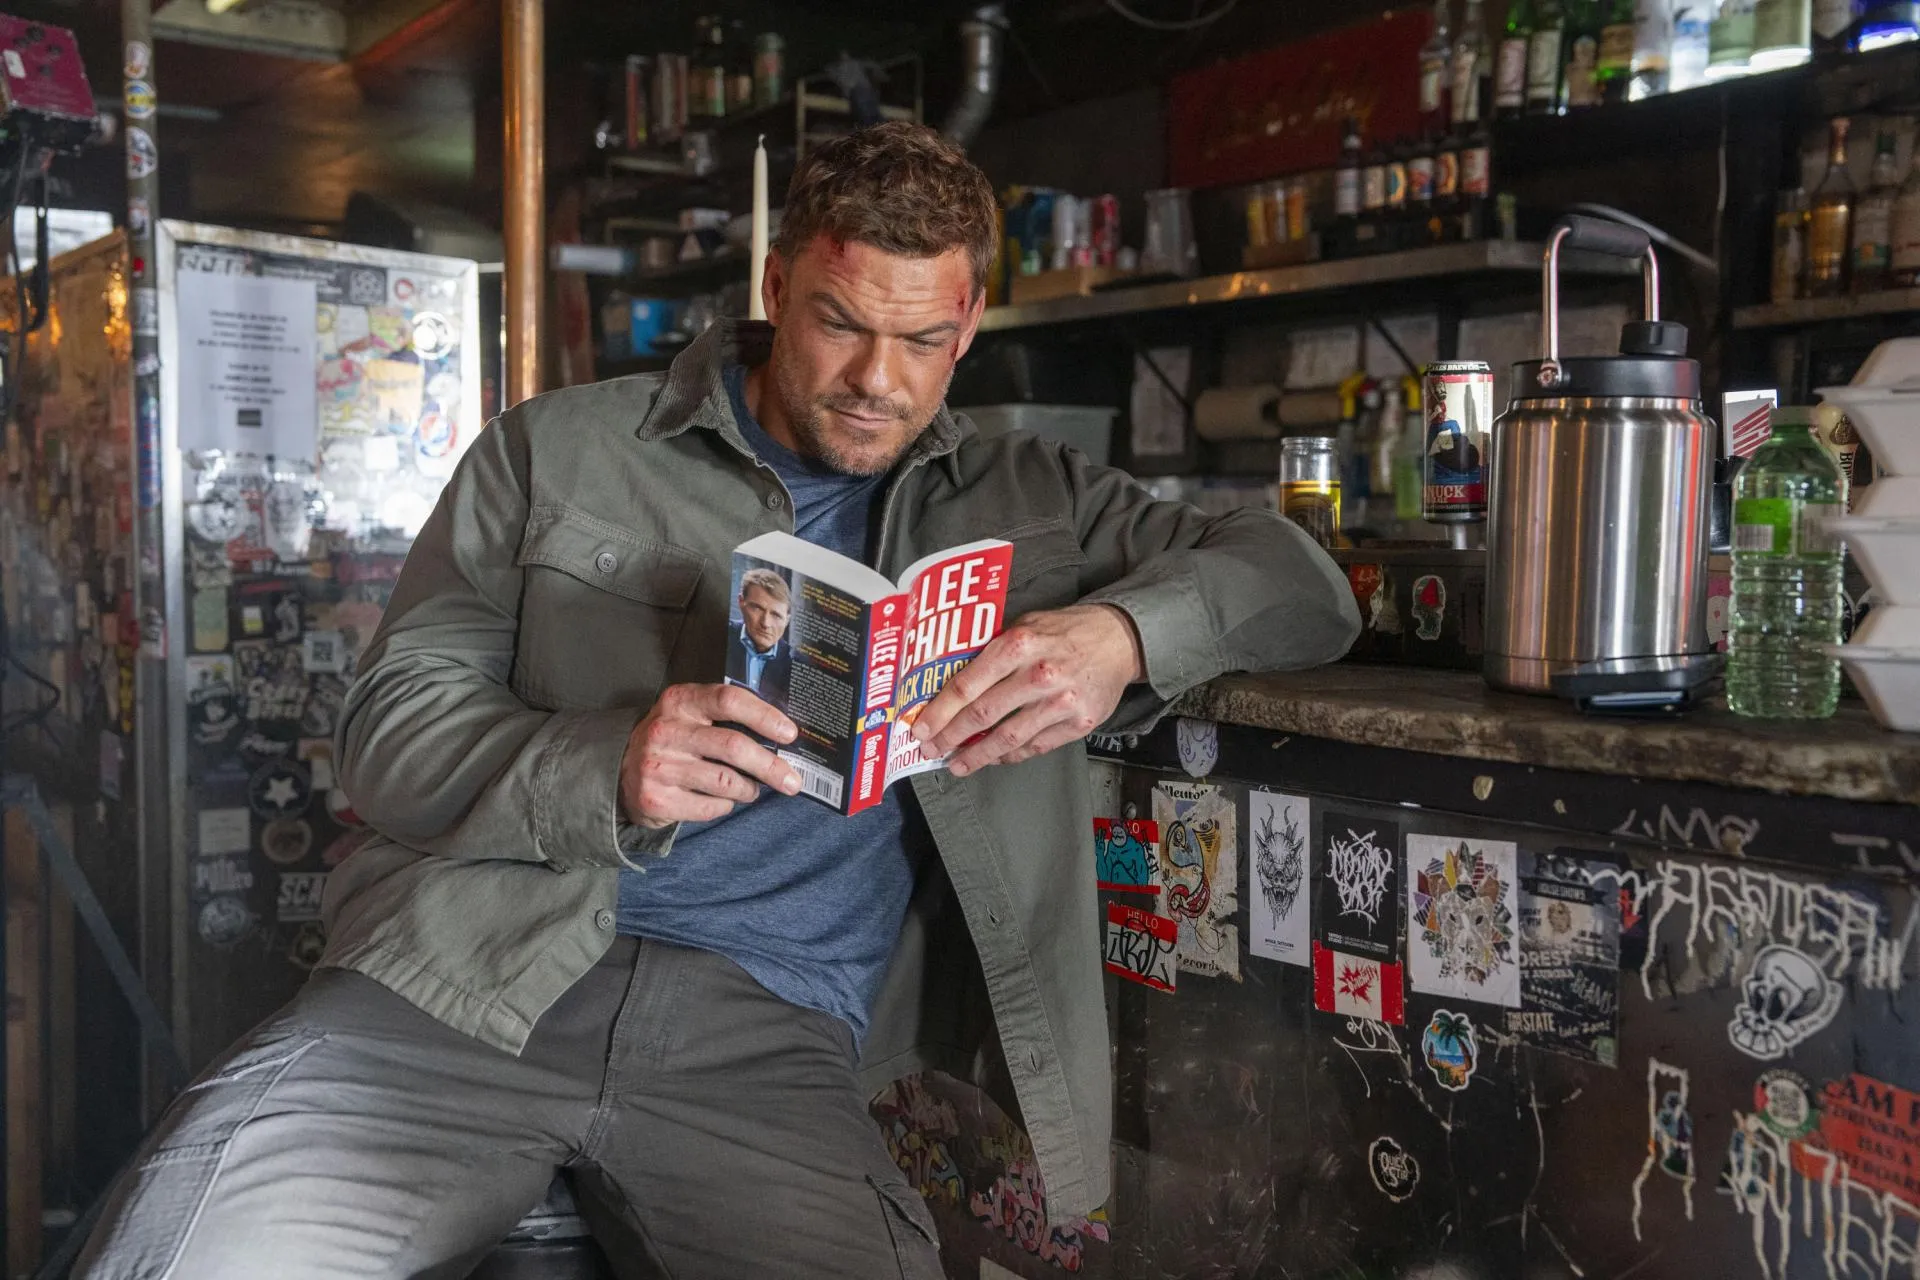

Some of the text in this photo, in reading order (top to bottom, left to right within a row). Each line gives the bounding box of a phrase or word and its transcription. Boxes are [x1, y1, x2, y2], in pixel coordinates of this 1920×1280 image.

[918, 557, 985, 622] LEE
[871, 637, 898, 667] LEE
[901, 602, 996, 677] CHILD
[866, 664, 895, 709] CHILD
[921, 659, 970, 696] REAC
[859, 734, 883, 801] Gone Tomorrow
[1127, 909, 1159, 929] HELLO
[1519, 950, 1572, 968] OREST
[1522, 1012, 1557, 1033] STATE
